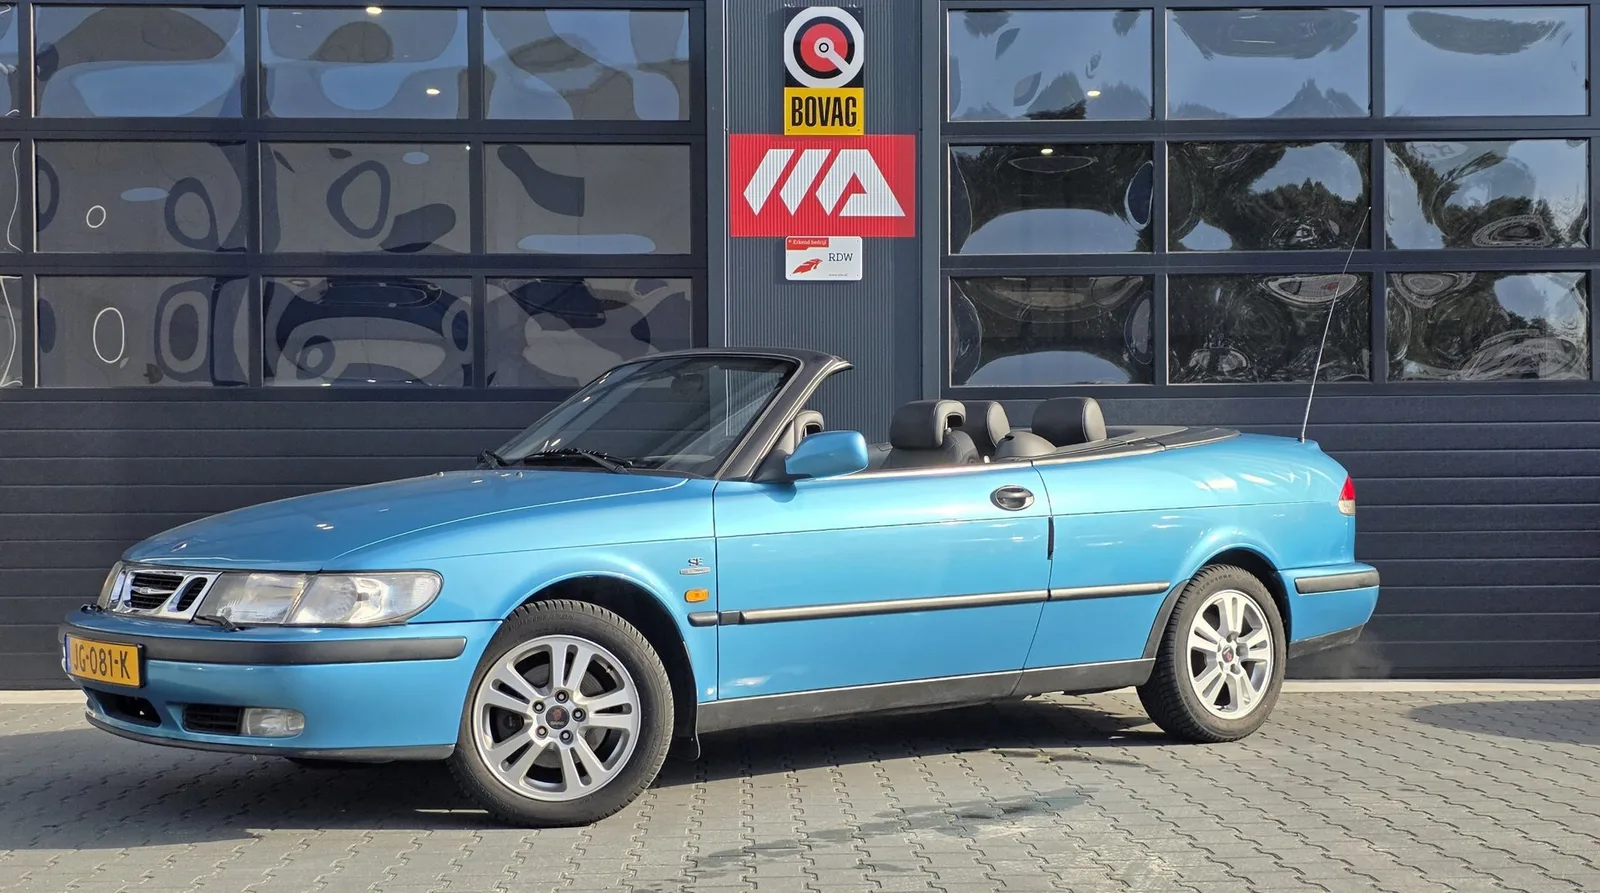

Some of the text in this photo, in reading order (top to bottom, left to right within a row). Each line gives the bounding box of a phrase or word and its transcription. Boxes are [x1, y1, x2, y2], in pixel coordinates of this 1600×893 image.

[792, 96, 857, 127] BOVAG
[828, 252, 853, 262] RDW
[74, 643, 131, 680] JG-081-K
